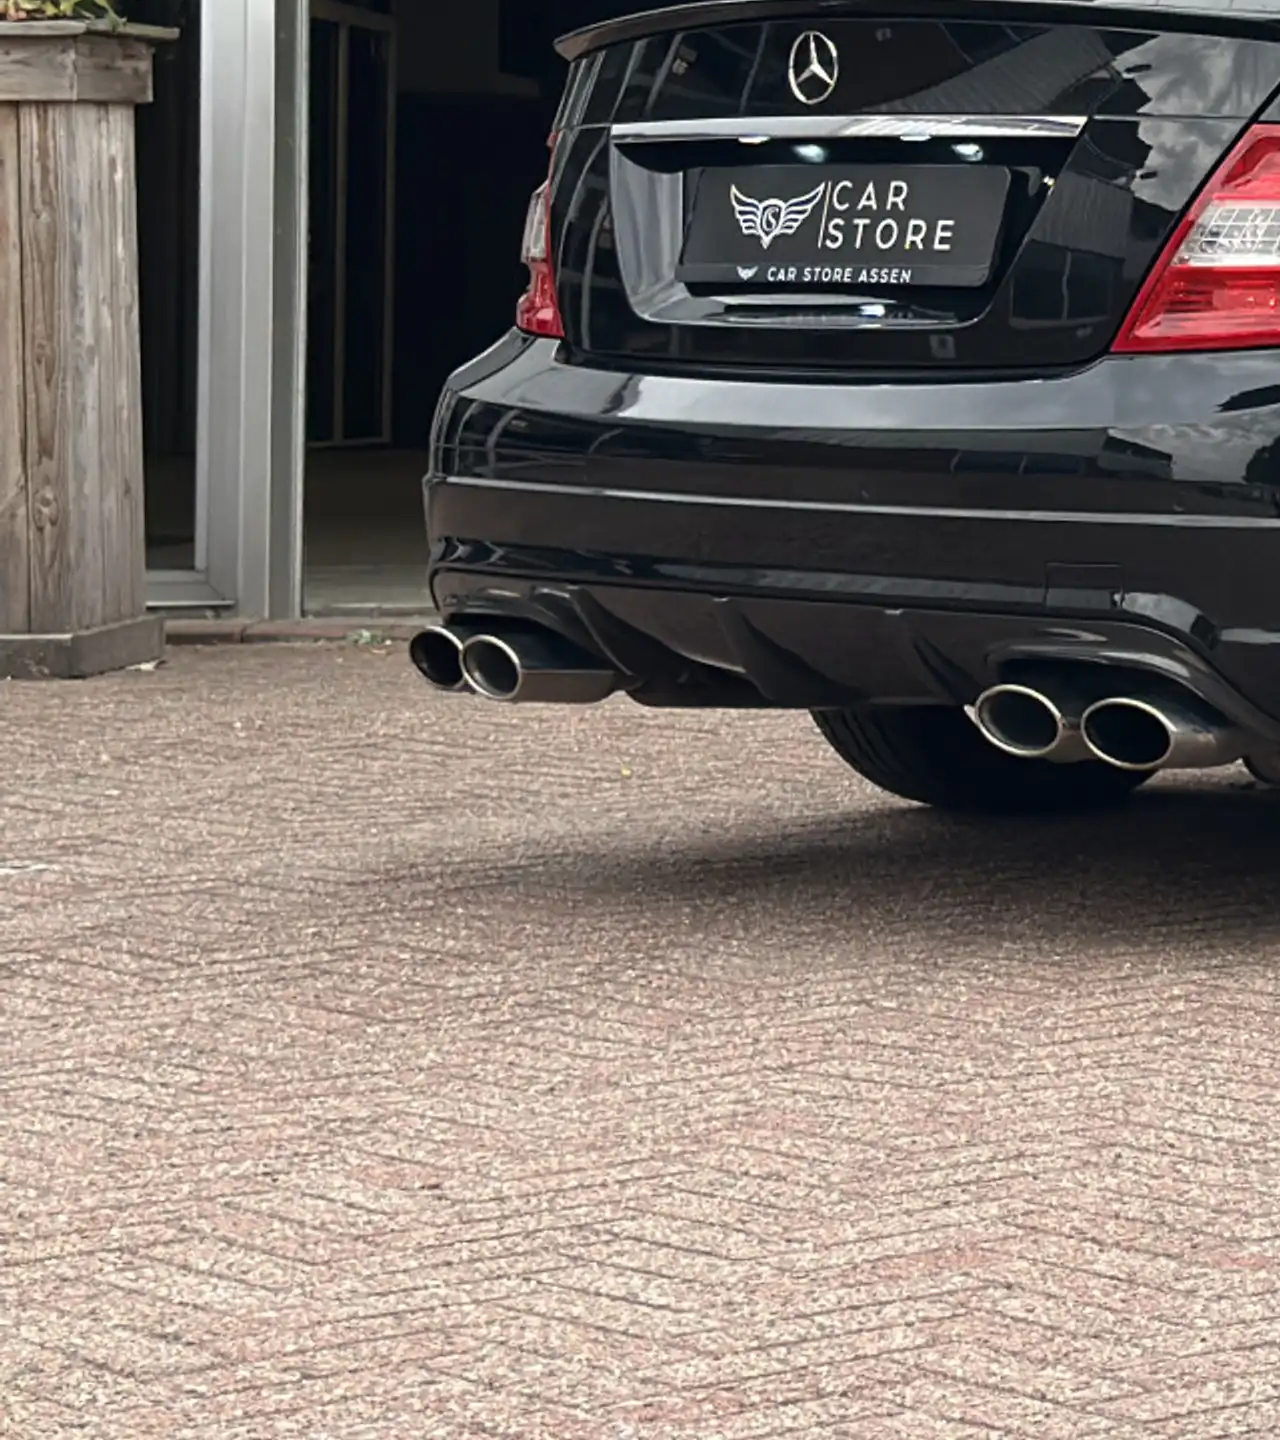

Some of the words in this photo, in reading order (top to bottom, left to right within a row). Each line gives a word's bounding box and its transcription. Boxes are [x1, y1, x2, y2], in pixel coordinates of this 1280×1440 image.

[832, 180, 909, 211] CAR
[826, 218, 956, 250] STORE
[767, 267, 797, 282] CAR
[802, 267, 853, 283] STORE
[858, 268, 912, 284] ASSEN
